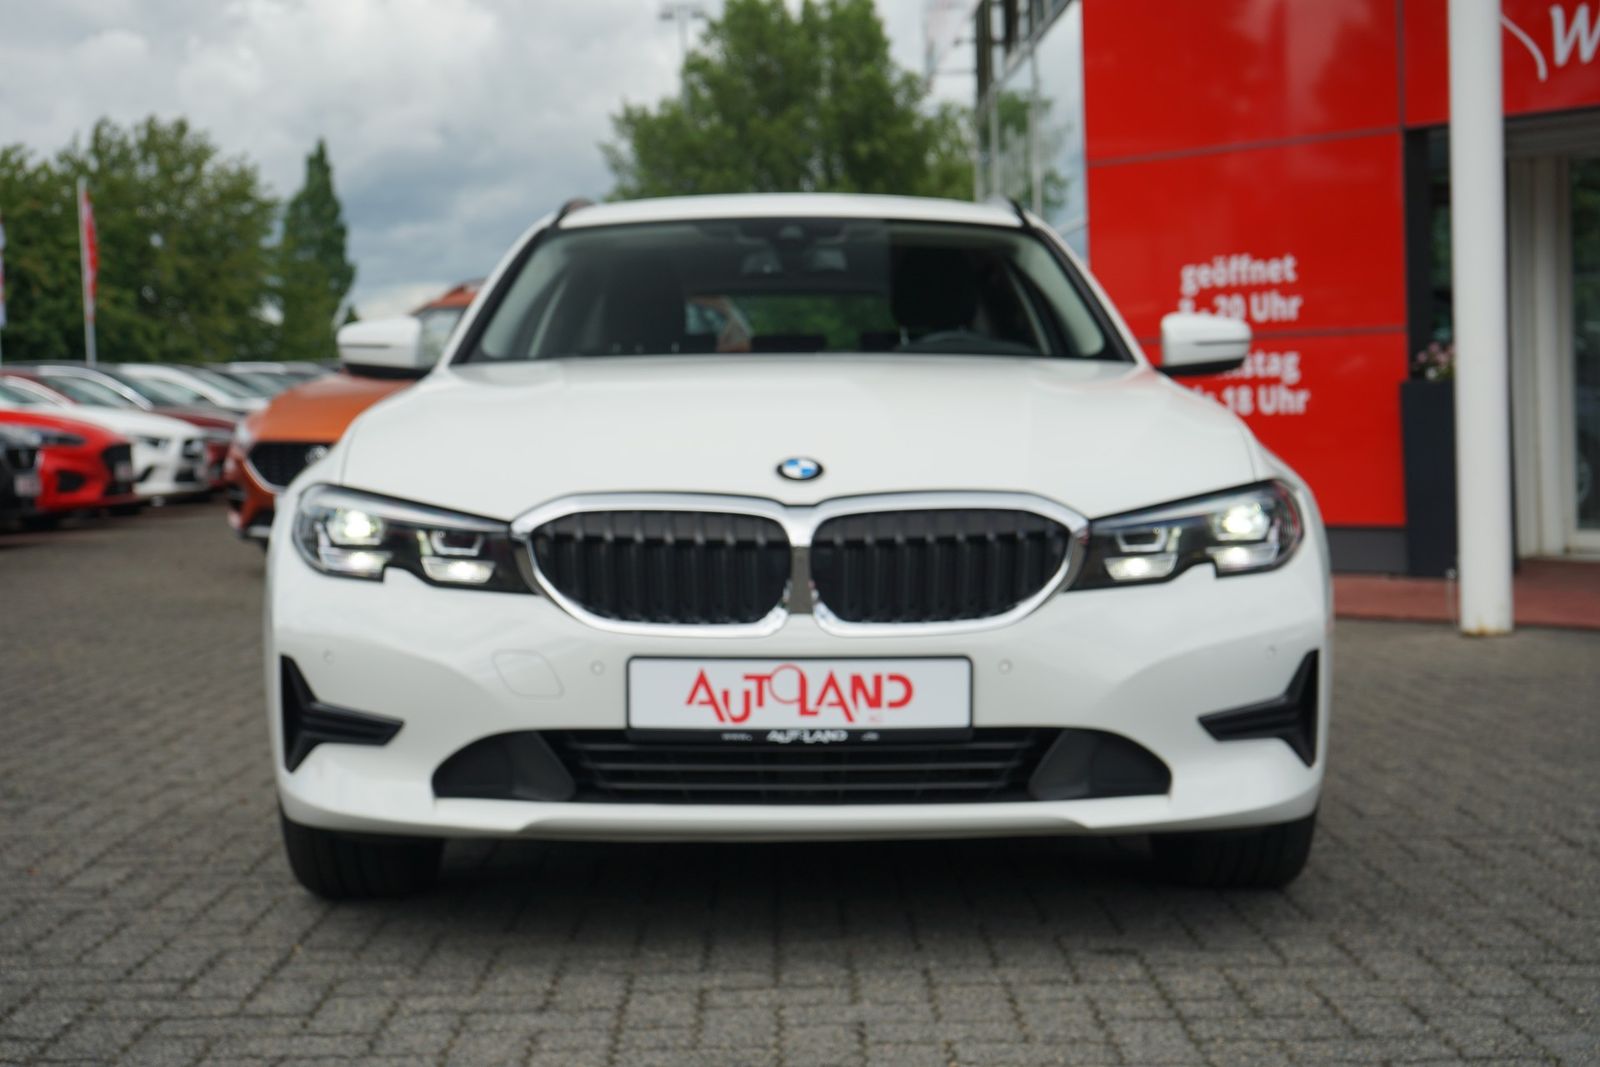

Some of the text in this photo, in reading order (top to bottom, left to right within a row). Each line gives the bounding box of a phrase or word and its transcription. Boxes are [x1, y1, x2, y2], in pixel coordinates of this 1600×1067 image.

[1180, 253, 1297, 297] geöffnet
[1250, 290, 1302, 322] Uhr
[1222, 384, 1254, 416] 18
[1257, 384, 1311, 415] Uhr
[685, 664, 914, 723] AUTOLAND
